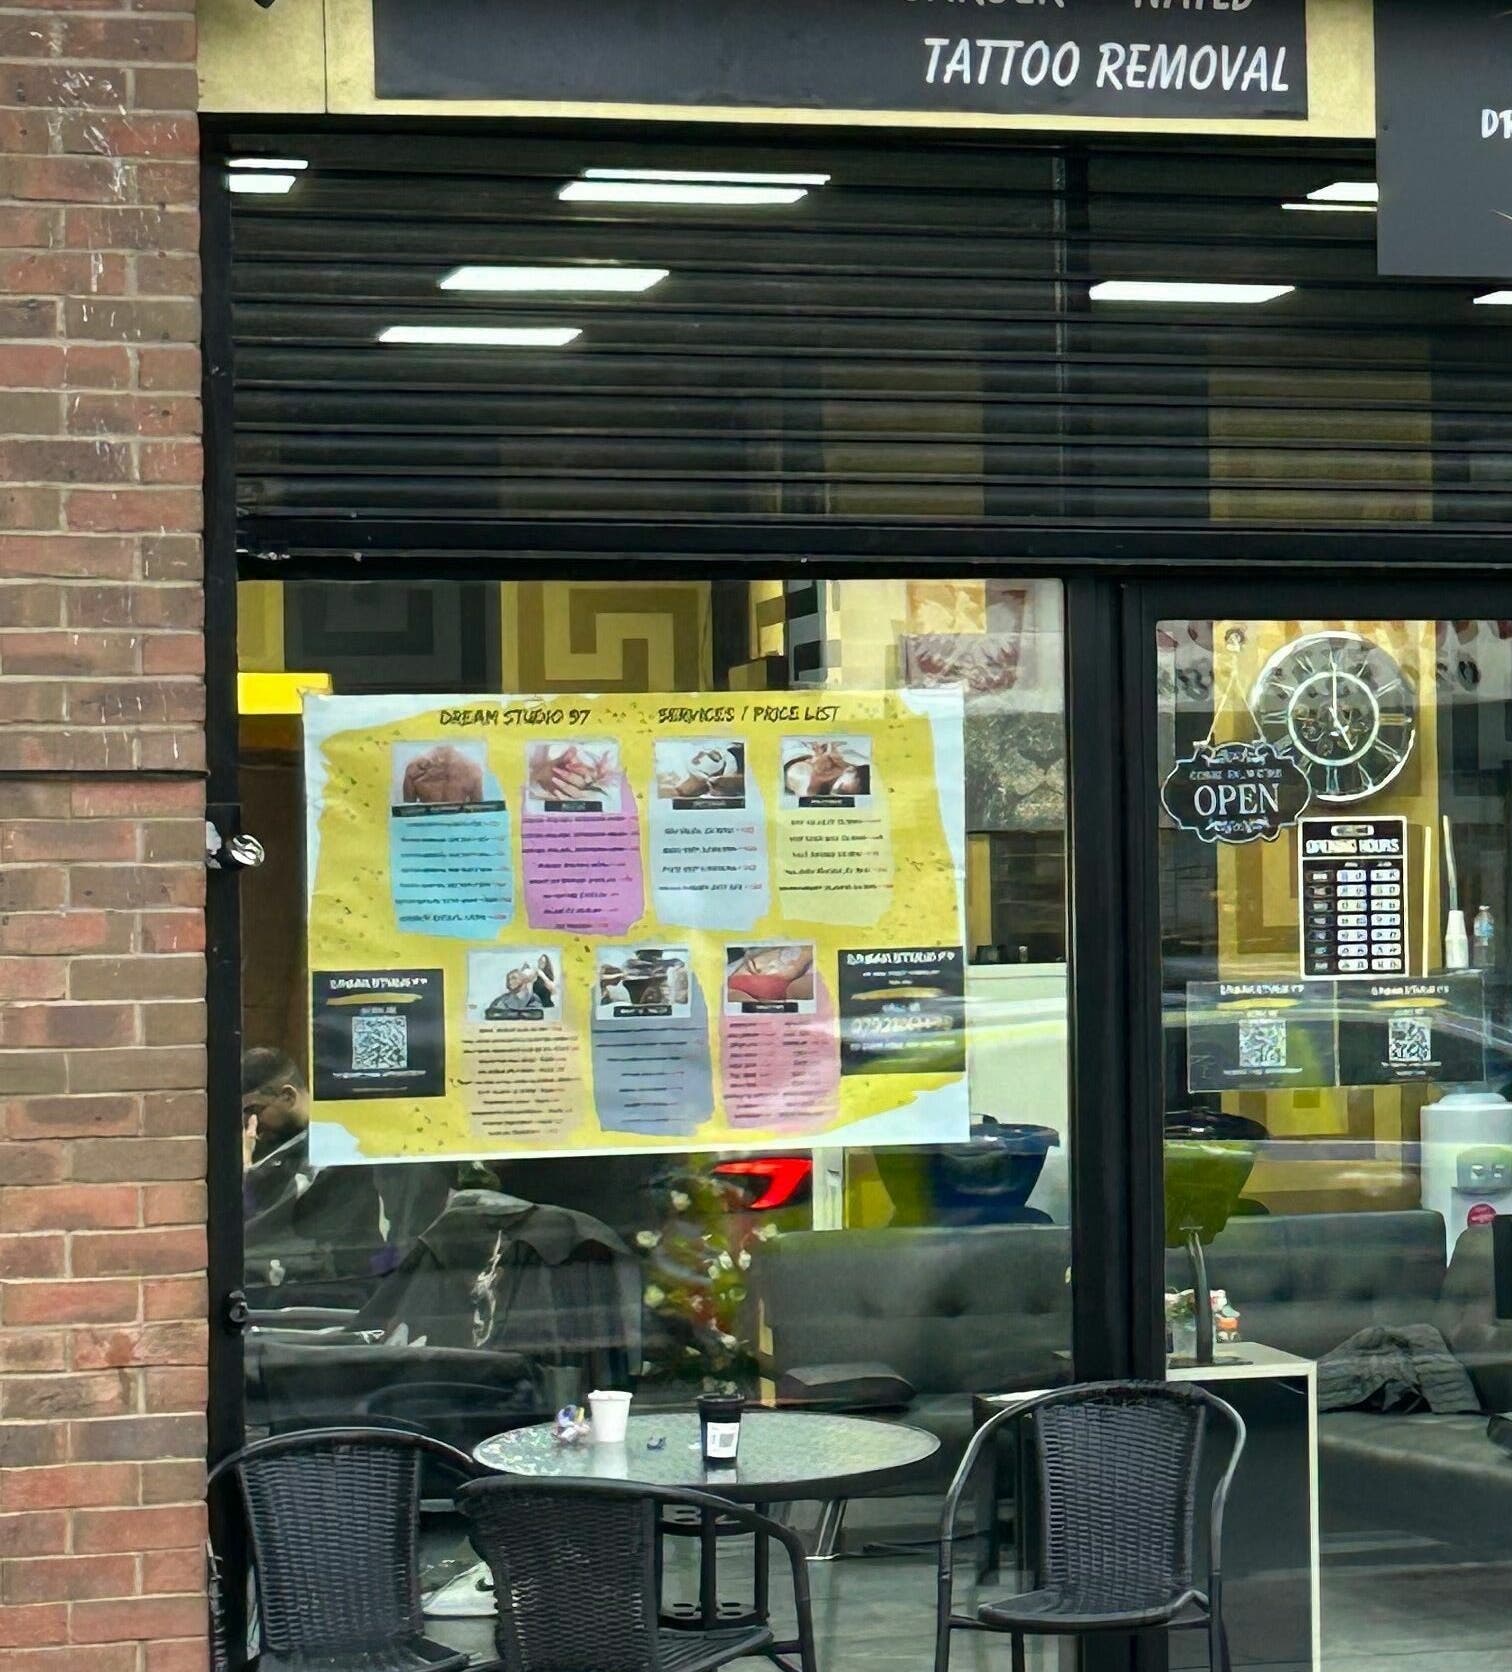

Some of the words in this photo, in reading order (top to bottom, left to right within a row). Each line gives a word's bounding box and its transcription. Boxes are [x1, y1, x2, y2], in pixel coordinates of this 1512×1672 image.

[924, 38, 1080, 87] TATTOO
[1096, 42, 1289, 92] REMOVAL
[439, 708, 499, 726] DREAM
[503, 707, 564, 725] STUDIO
[567, 709, 592, 725] 97
[658, 706, 735, 724] SERVICES
[753, 706, 800, 723] PRICE
[804, 705, 841, 722] LIST
[1194, 782, 1280, 817] OPEN
